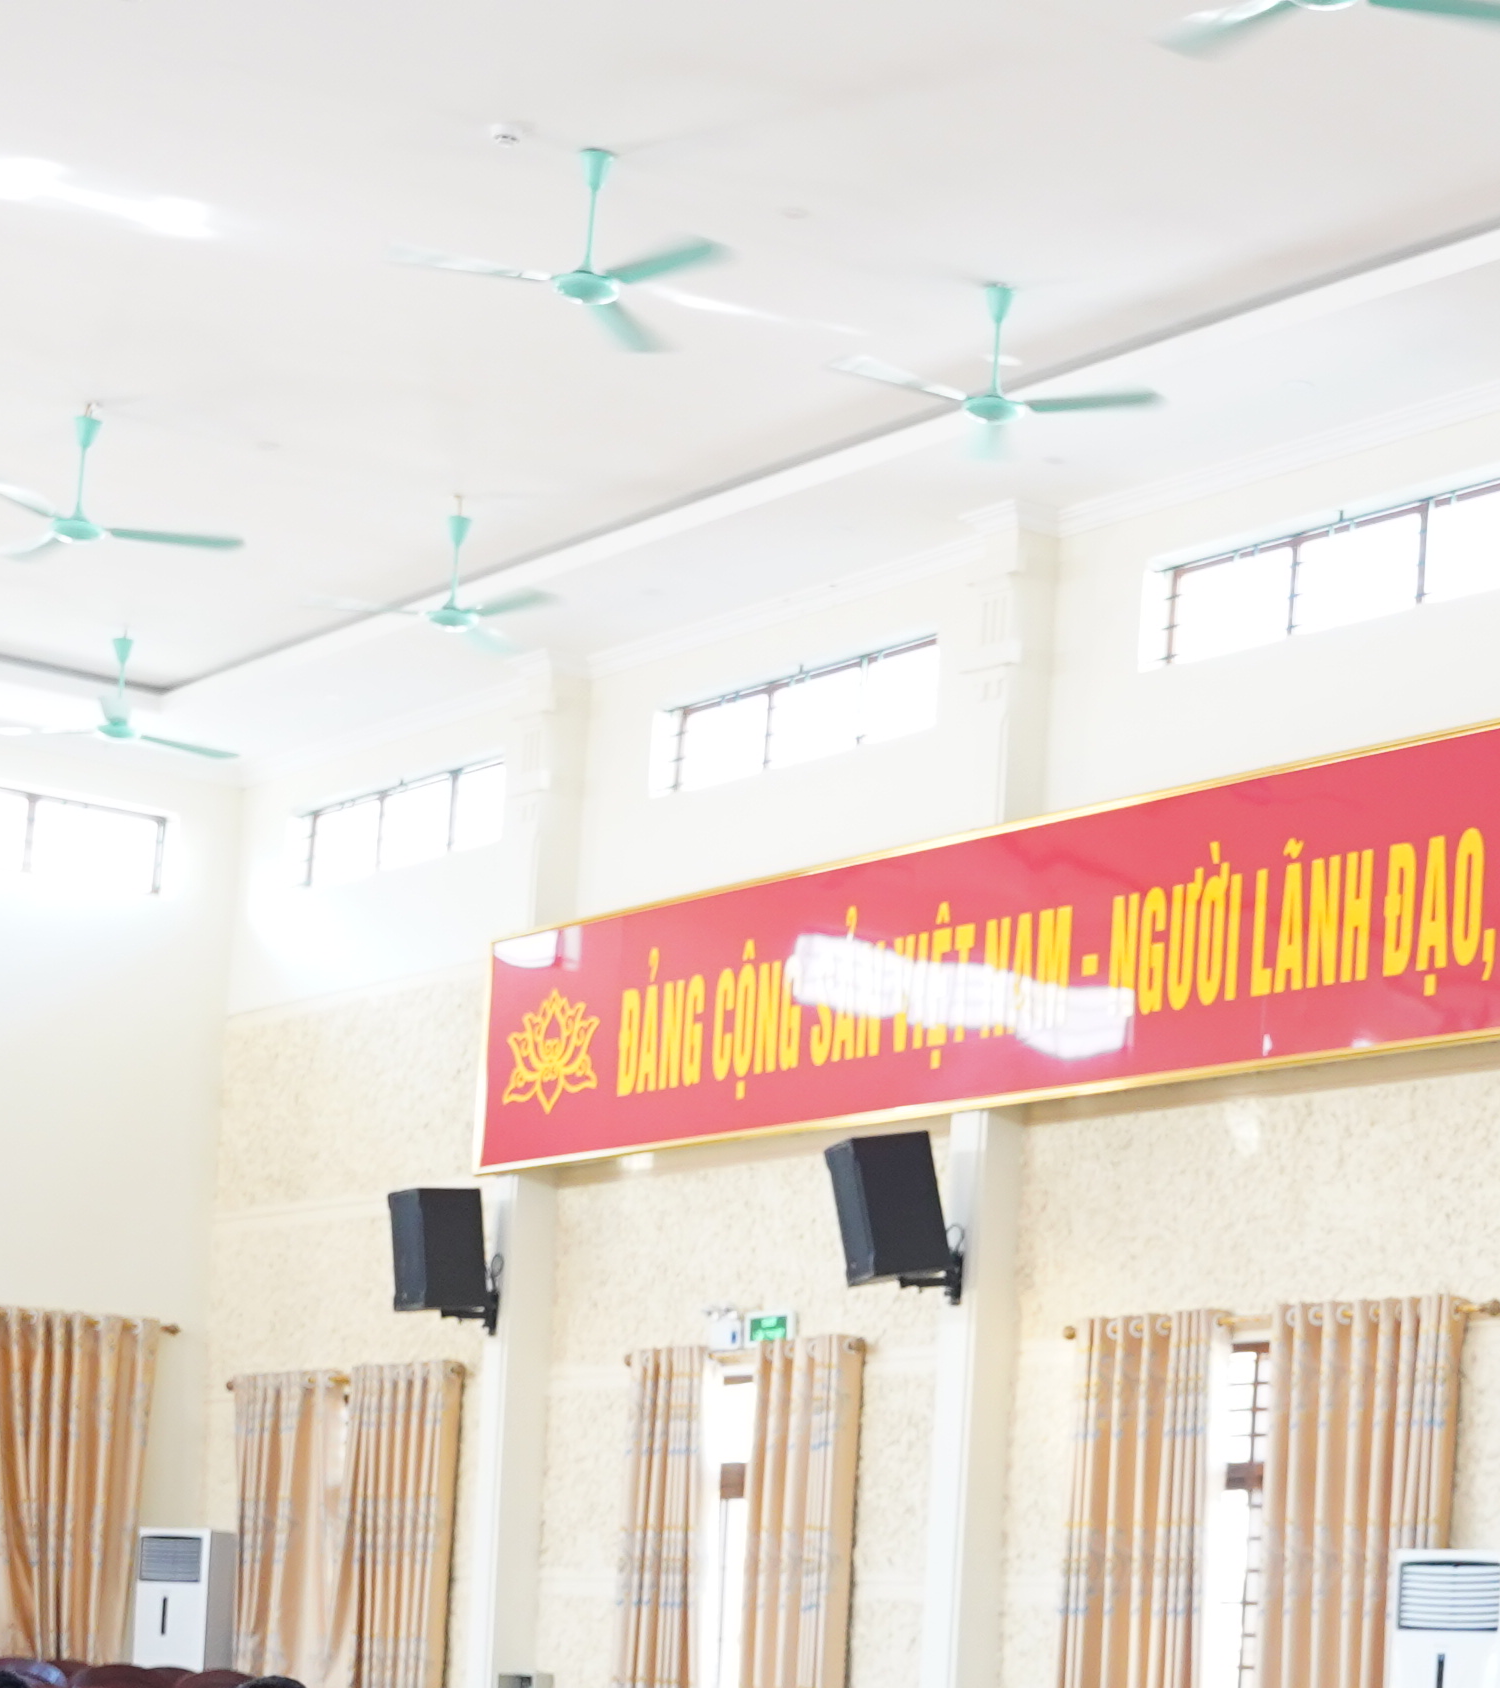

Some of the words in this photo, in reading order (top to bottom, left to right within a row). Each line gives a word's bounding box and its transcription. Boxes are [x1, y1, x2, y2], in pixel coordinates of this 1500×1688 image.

[616, 946, 706, 1097] ĐẢNG
[712, 938, 801, 1100] CỘNG
[1108, 841, 1243, 1015] NGƯỜI
[1250, 837, 1375, 997] LÃNH
[1383, 826, 1496, 996] ĐẠO,
